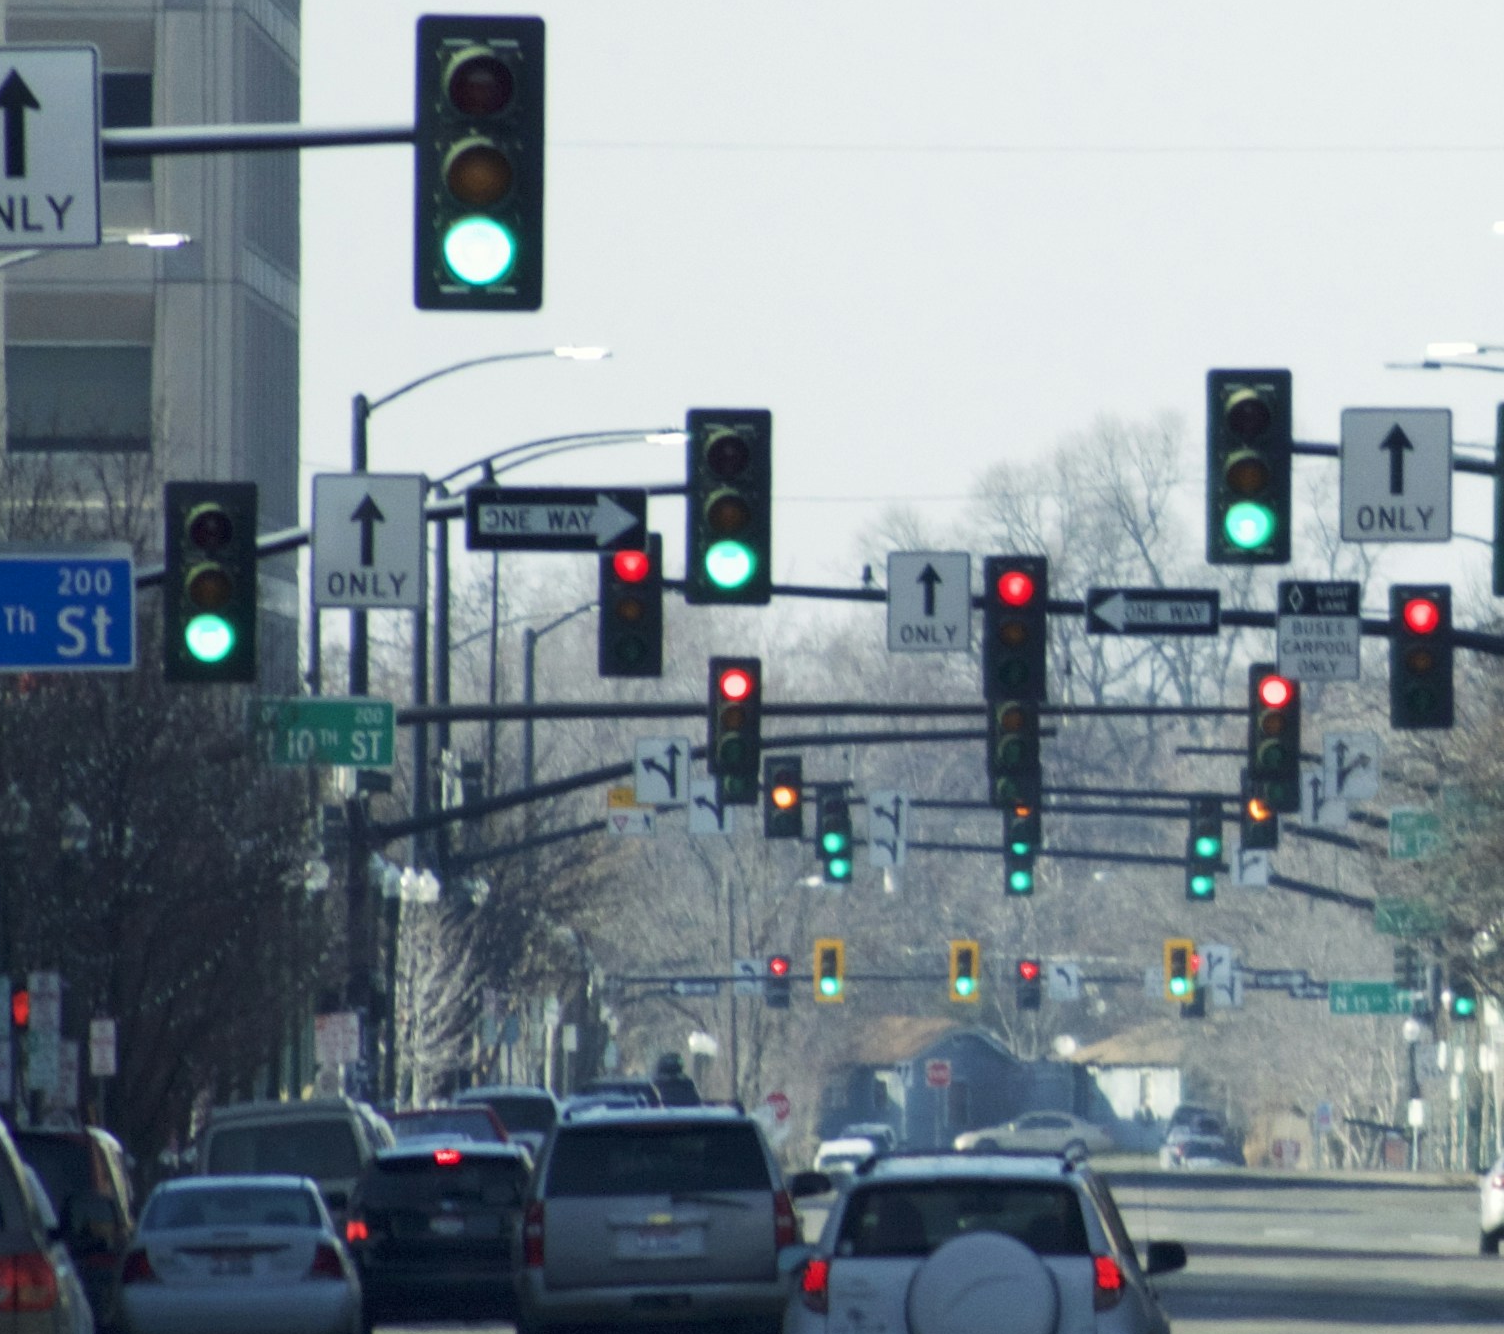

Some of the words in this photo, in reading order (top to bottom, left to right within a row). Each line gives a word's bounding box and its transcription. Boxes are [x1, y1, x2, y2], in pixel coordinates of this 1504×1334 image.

[484, 508, 531, 531] ONE
[545, 509, 594, 531] WAY
[1356, 503, 1435, 532] ONLY
[57, 567, 113, 597] 200
[327, 571, 408, 599] ONLY
[1123, 602, 1158, 622] ONE
[1169, 603, 1203, 623] WAY
[2, 604, 36, 634] Th
[56, 604, 114, 658] St
[899, 624, 958, 646] ONLY
[351, 729, 384, 763] ST
